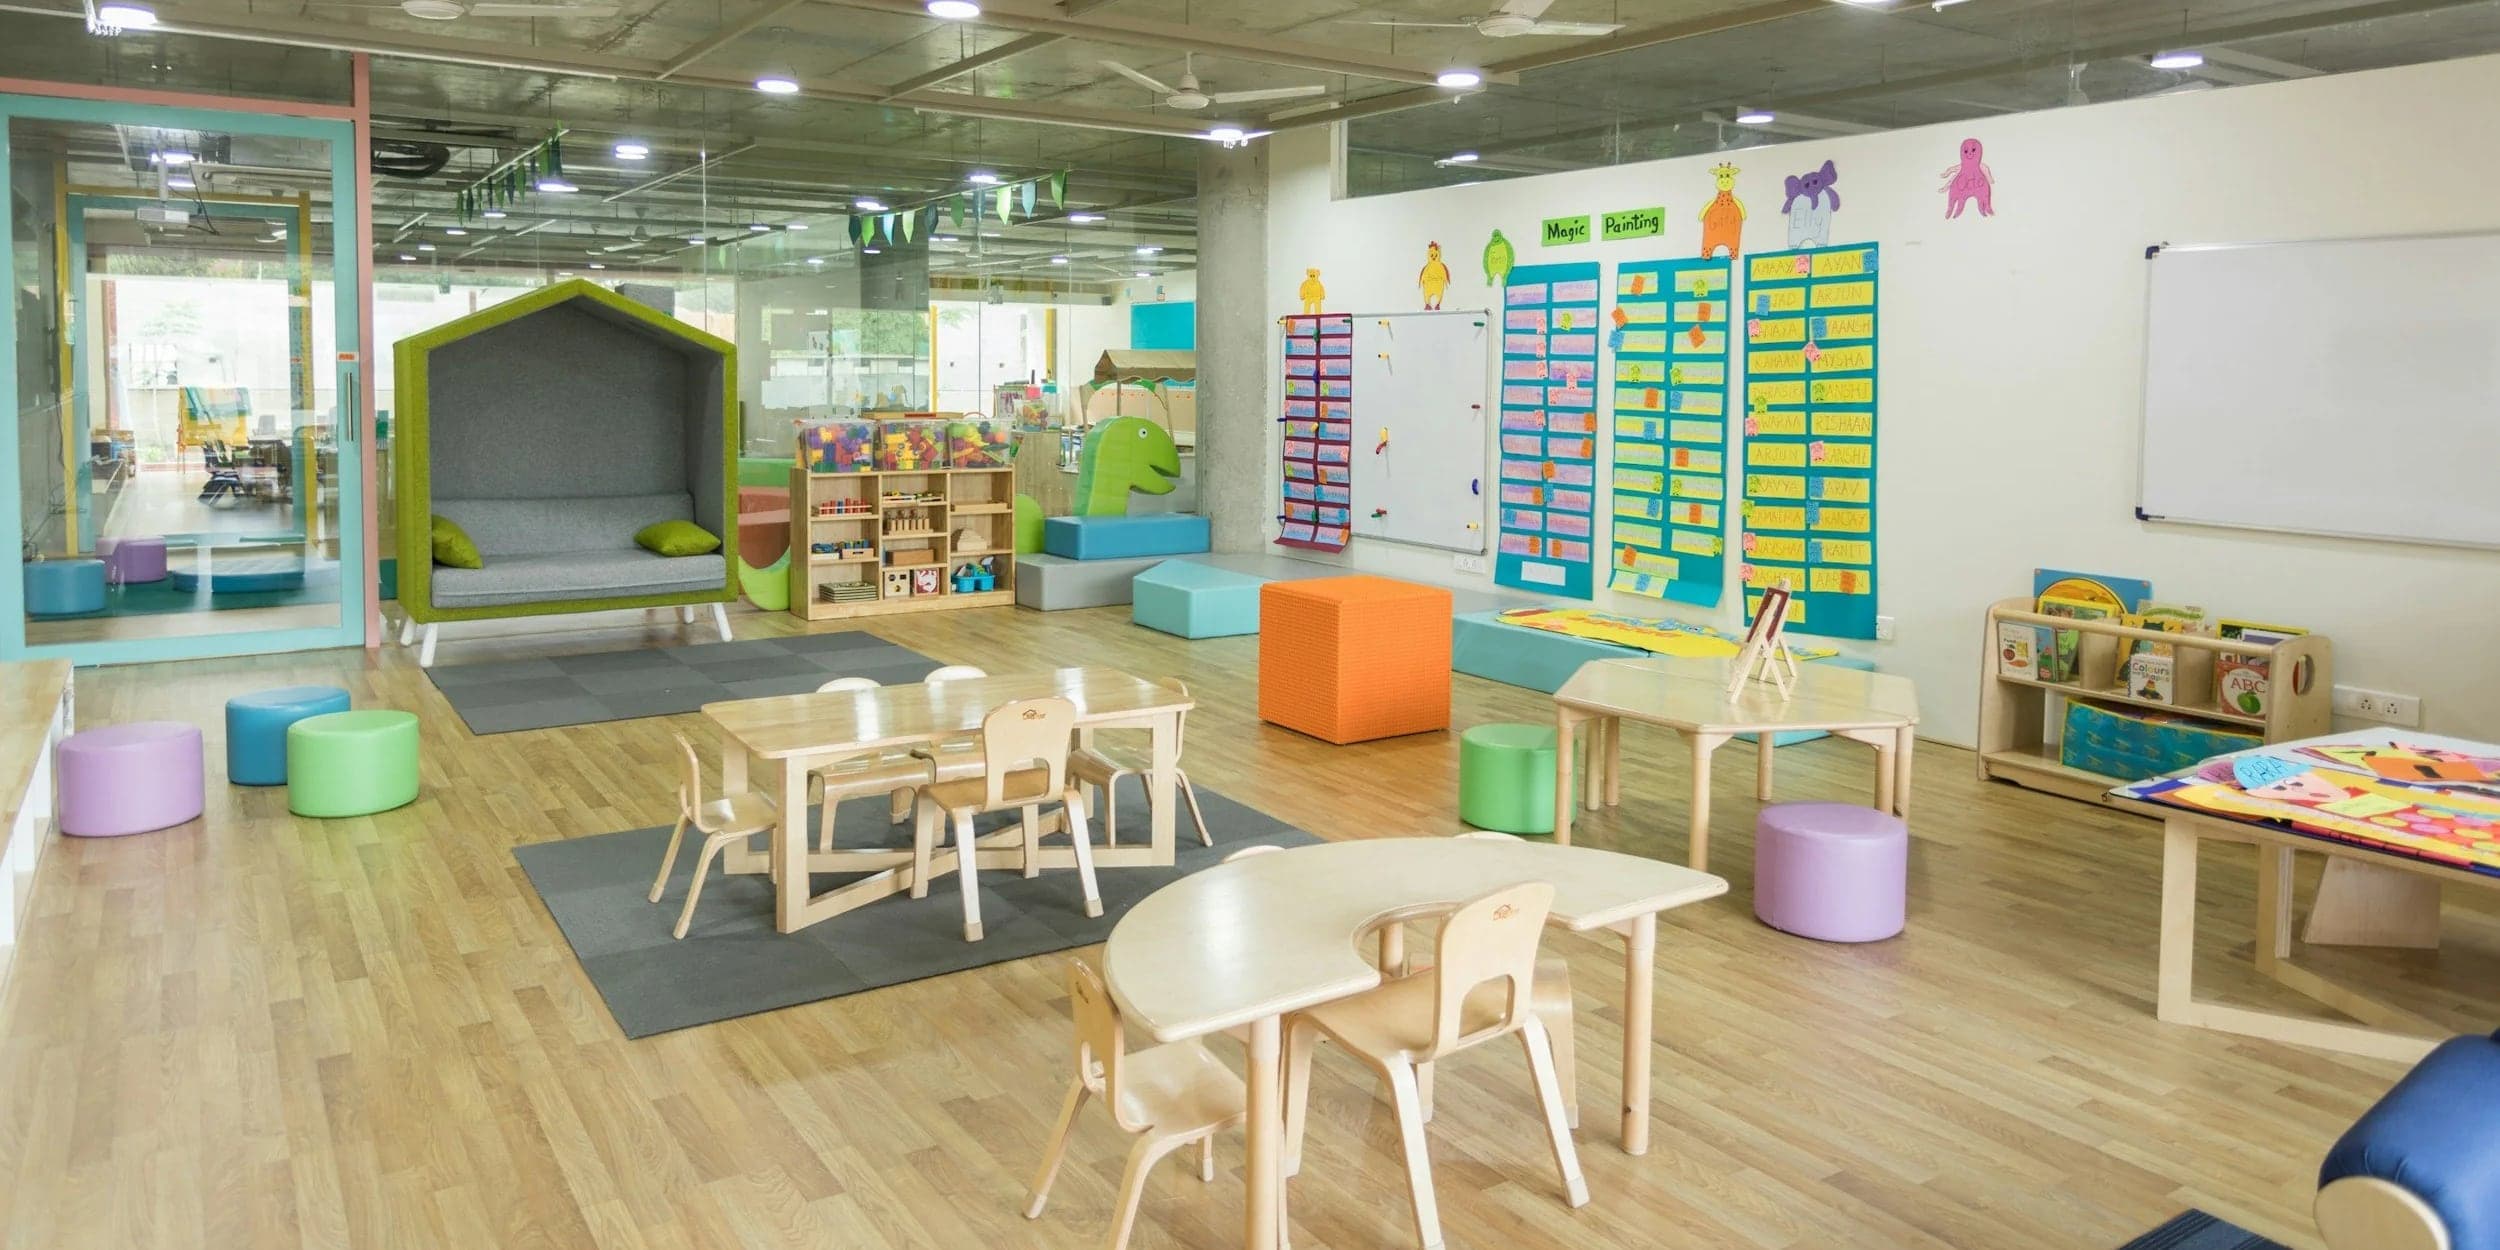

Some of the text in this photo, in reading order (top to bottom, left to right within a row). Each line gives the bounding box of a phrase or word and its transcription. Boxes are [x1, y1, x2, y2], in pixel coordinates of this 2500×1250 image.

[1547, 213, 1659, 241] Magic Painting
[1792, 208, 1823, 232] Elly
[2133, 662, 2169, 675] Colours
[2230, 677, 2266, 693] ABC
